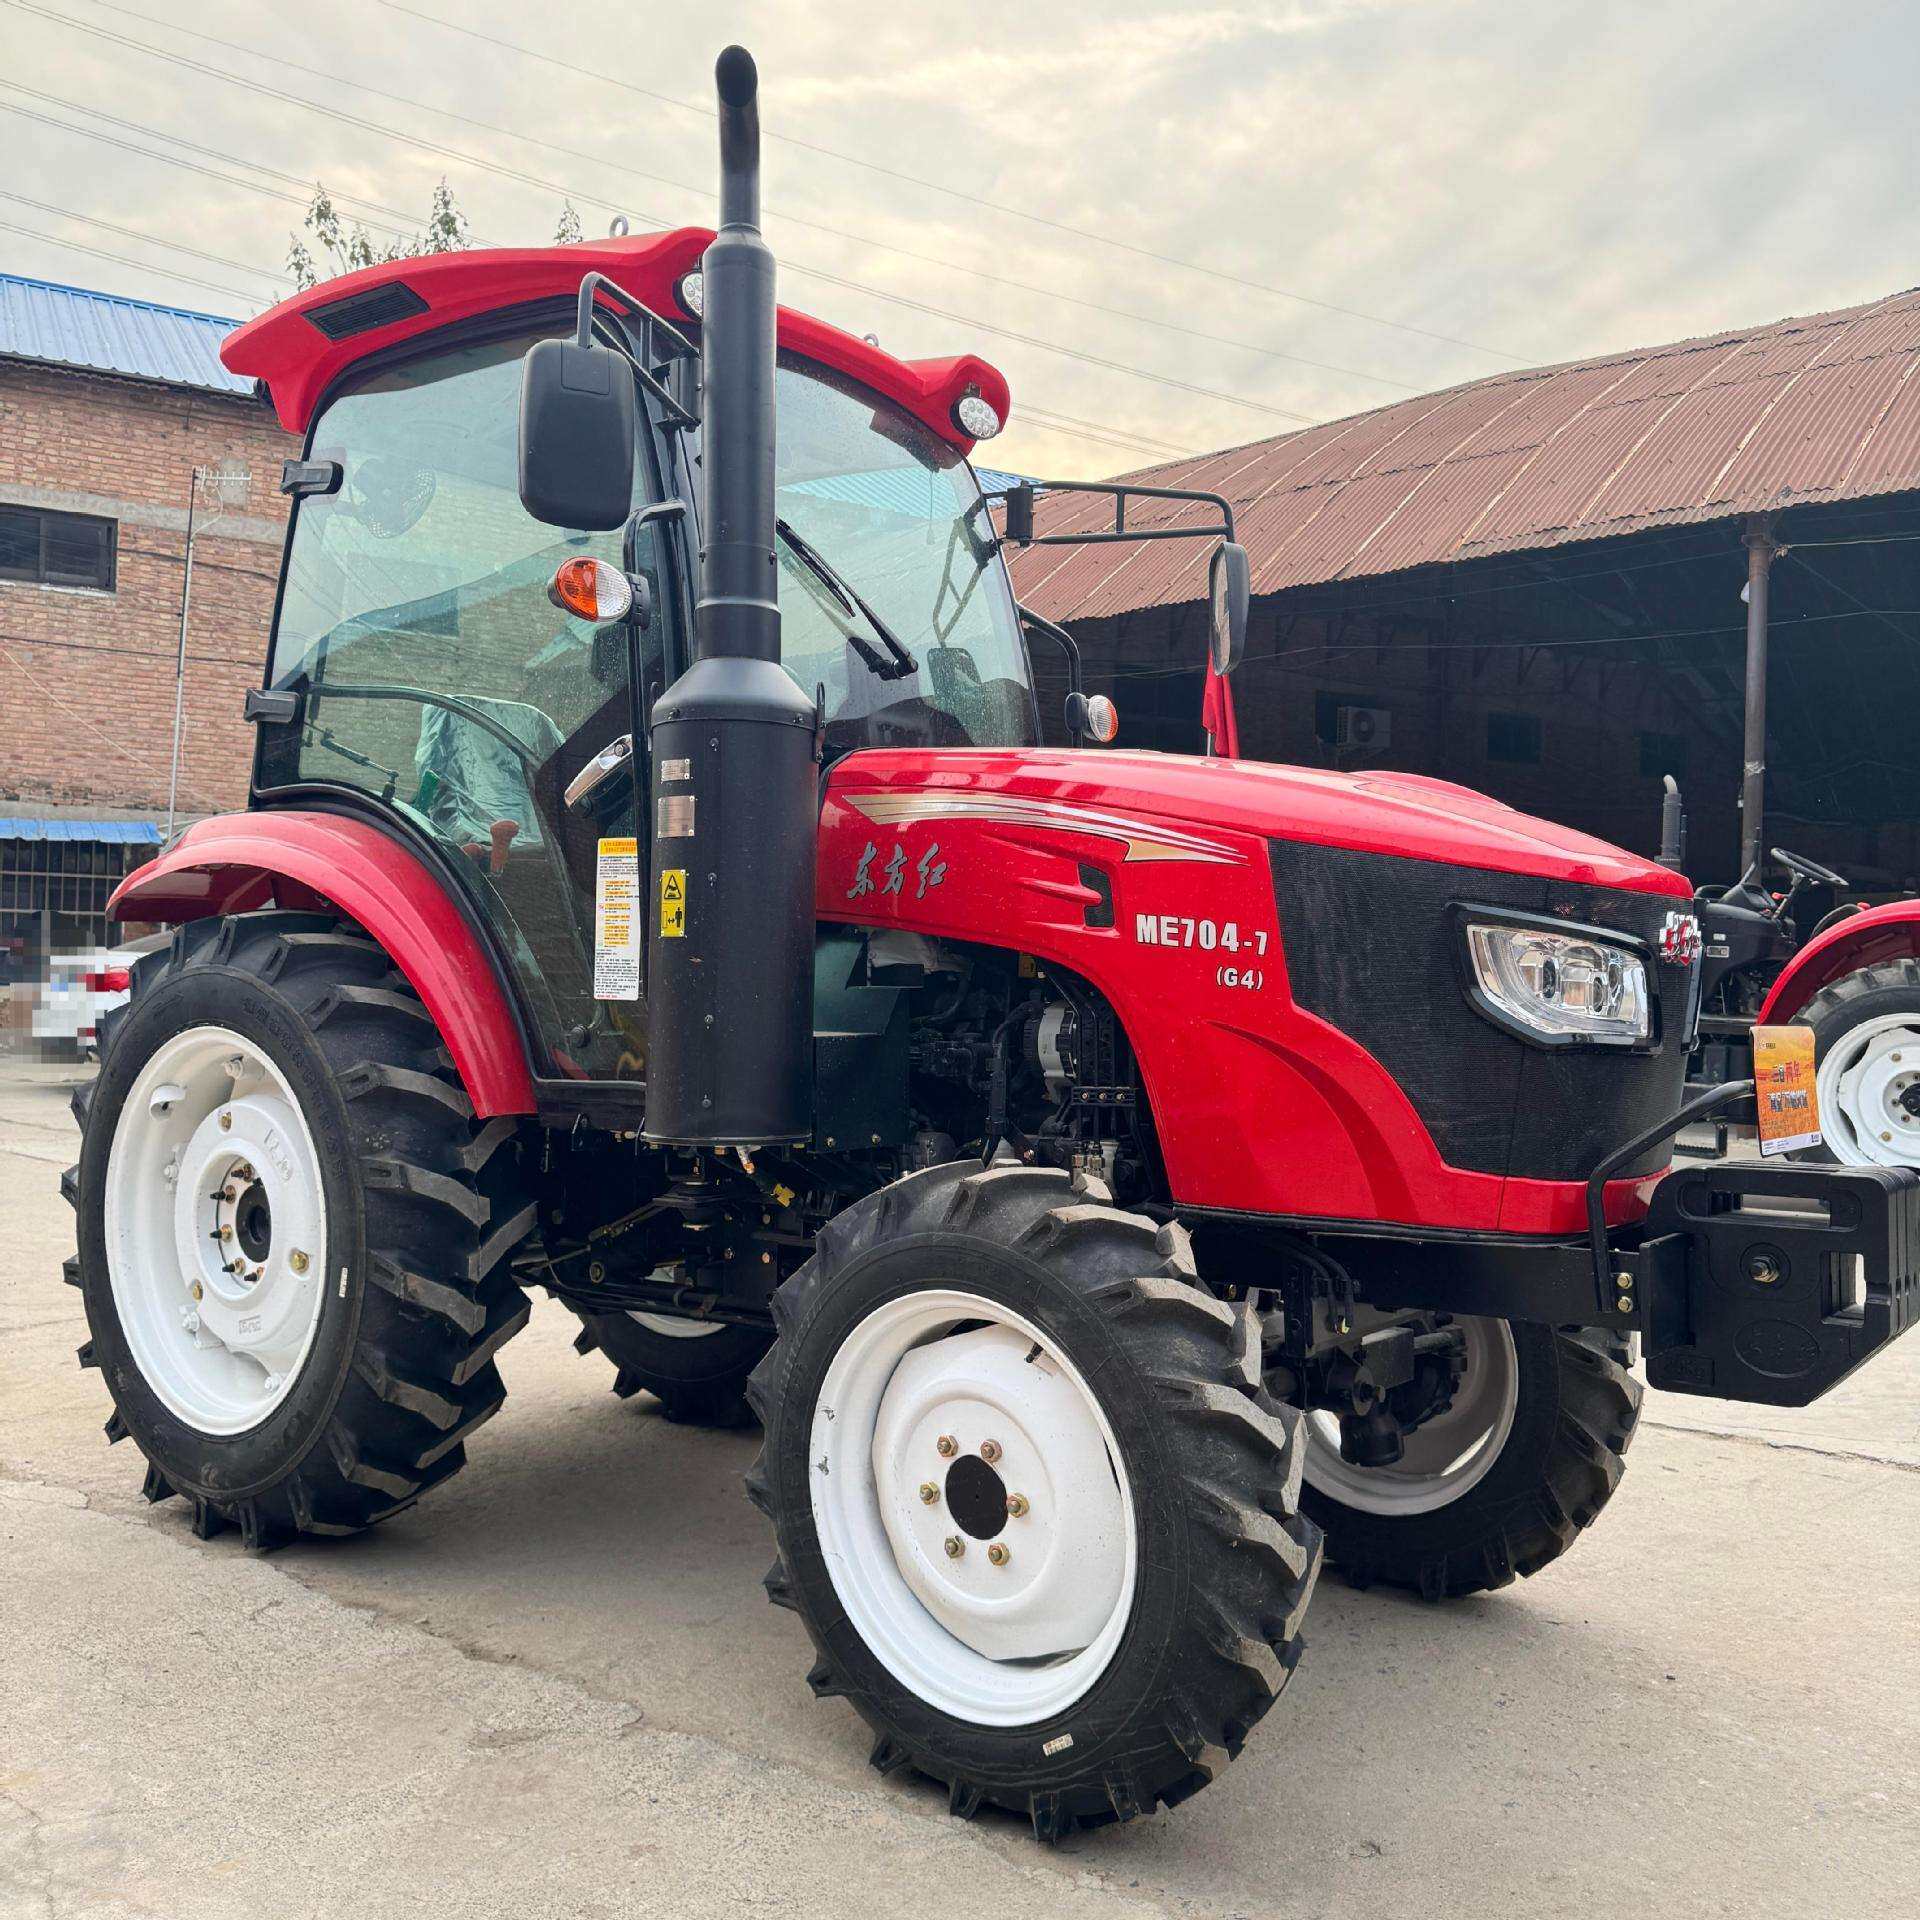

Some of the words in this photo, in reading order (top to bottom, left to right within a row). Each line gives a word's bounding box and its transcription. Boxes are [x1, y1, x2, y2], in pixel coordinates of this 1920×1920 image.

[848, 842, 947, 899] 东方红
[1136, 913, 1267, 955] ME704-7
[1216, 966, 1263, 990] (G4)
